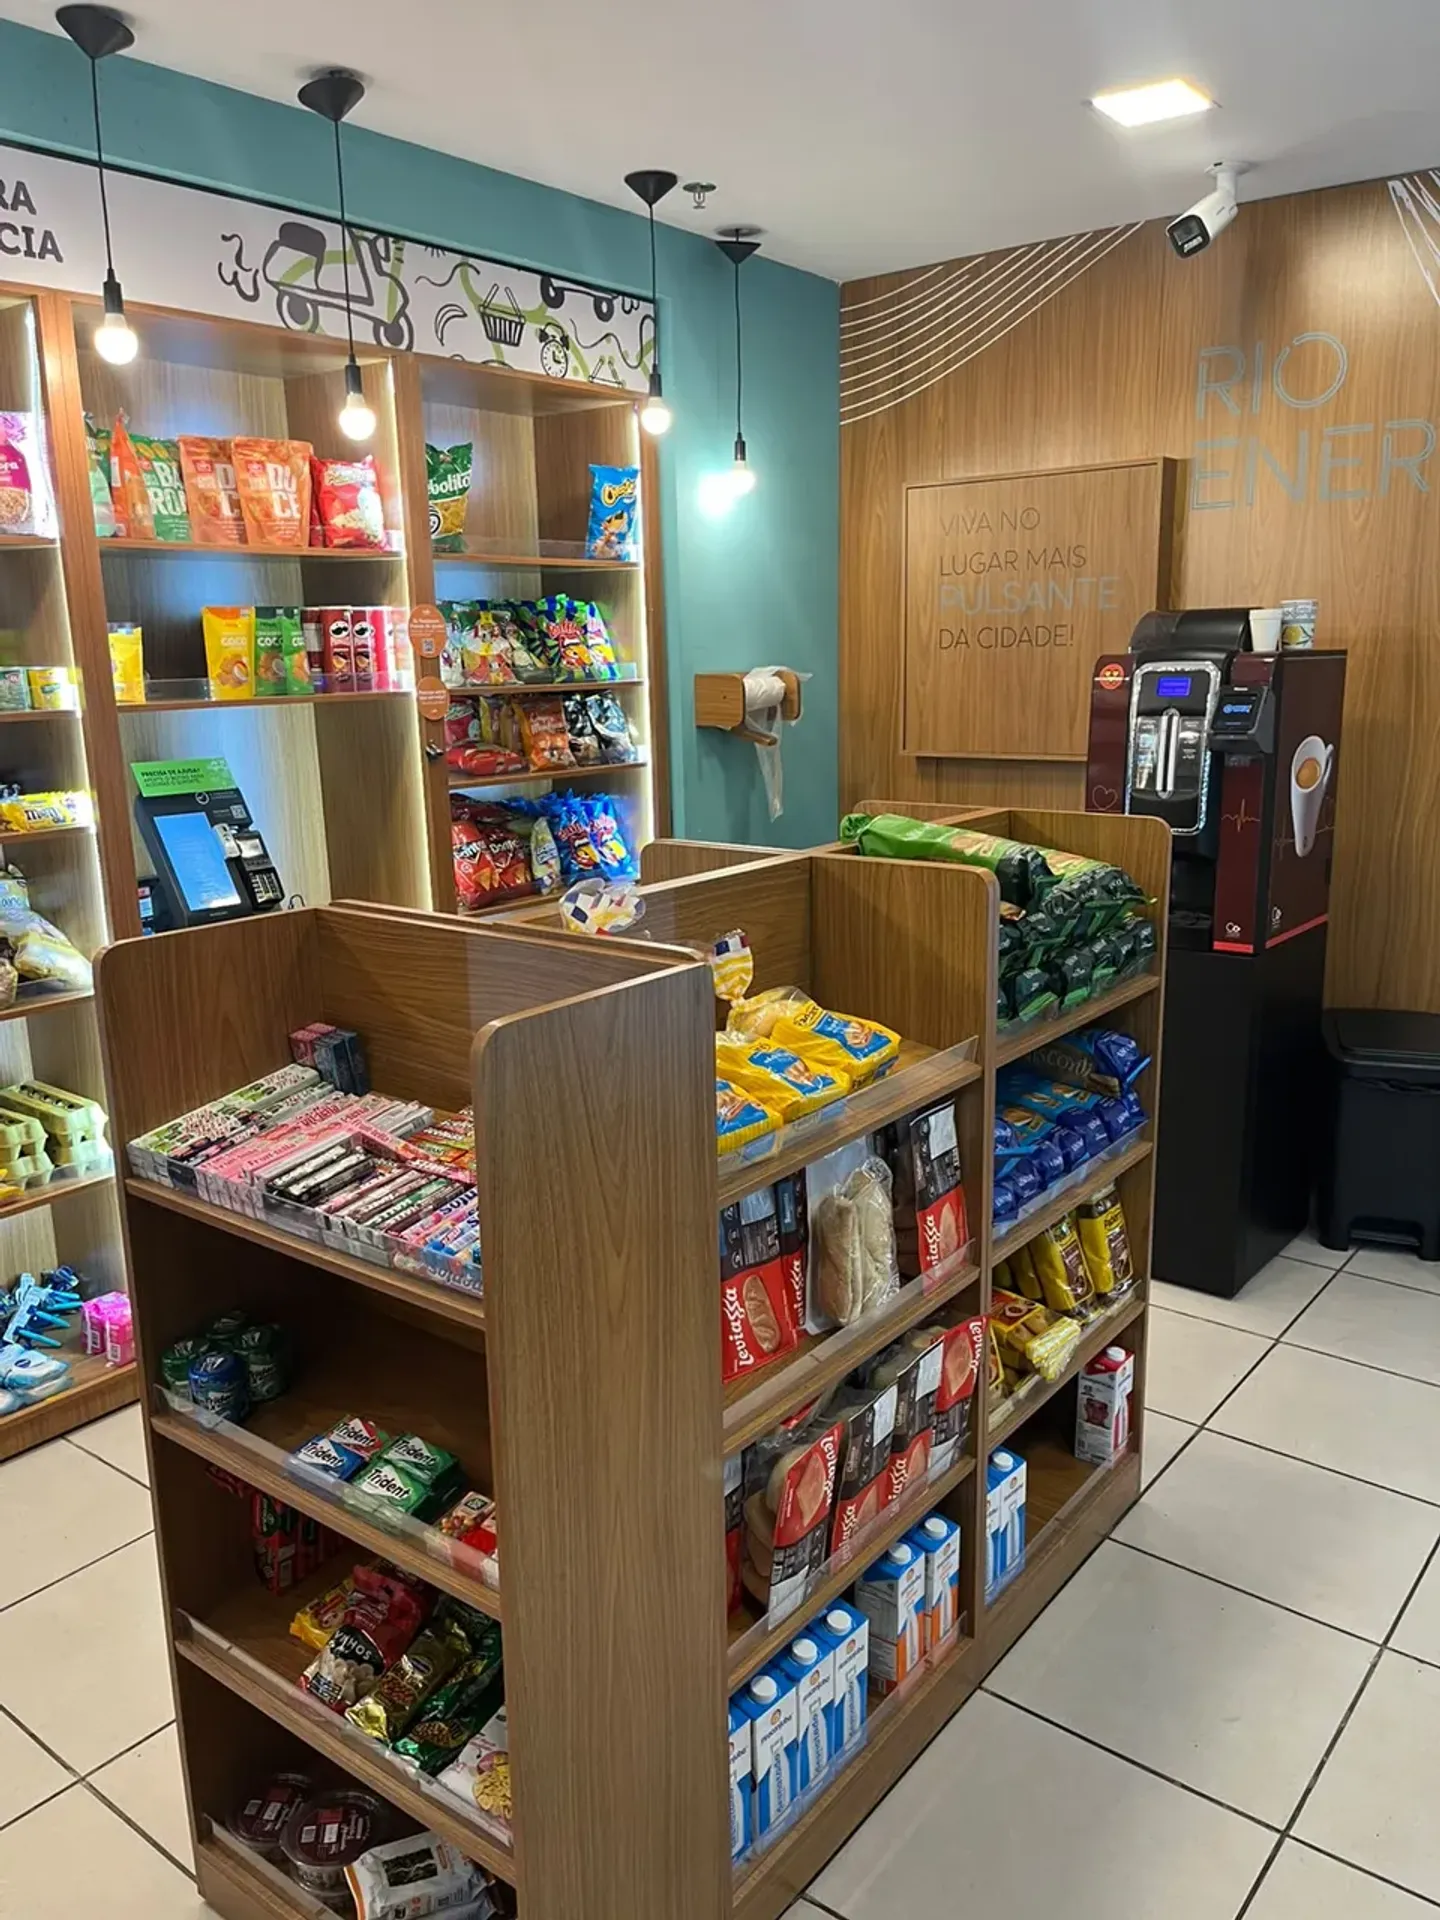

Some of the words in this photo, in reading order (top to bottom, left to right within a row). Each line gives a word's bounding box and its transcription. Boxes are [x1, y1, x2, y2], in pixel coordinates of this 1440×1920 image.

[1196, 331, 1347, 419] RIO
[1192, 418, 1436, 511] ENER
[940, 509, 993, 536] VIVA
[1001, 507, 1041, 531] NO
[940, 550, 1019, 576] LUGAR
[1027, 545, 1087, 571] MAIS
[938, 576, 1120, 615] PULSANTE
[939, 627, 970, 650] DA
[977, 624, 1074, 650] CIDADE!
[337, 1422, 376, 1447] Trident
[304, 1441, 345, 1467] Trident
[394, 1439, 437, 1465] Trident
[368, 1468, 411, 1498] Trident
